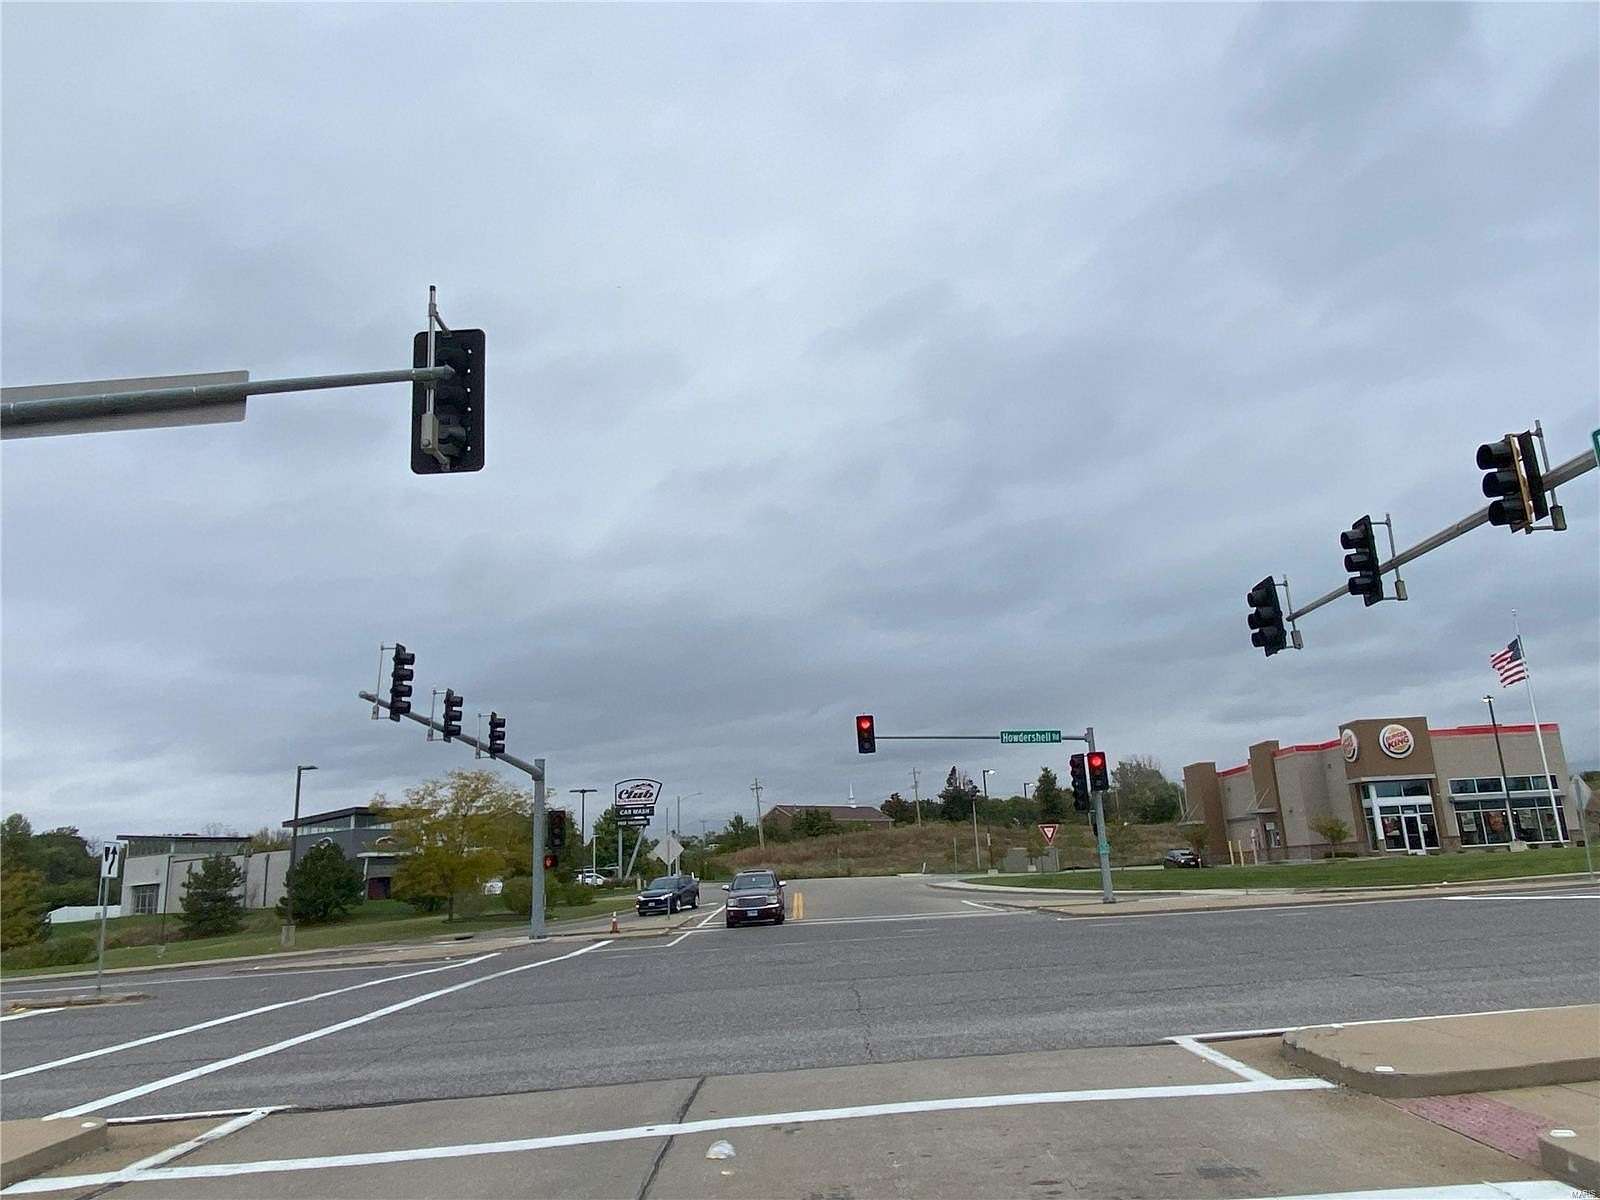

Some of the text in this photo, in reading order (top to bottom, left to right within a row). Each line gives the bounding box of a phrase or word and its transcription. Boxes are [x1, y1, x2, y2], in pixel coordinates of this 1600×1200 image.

[1002, 732, 1051, 742] Howdershell
[1388, 736, 1409, 749] KING
[617, 789, 654, 800] Club
